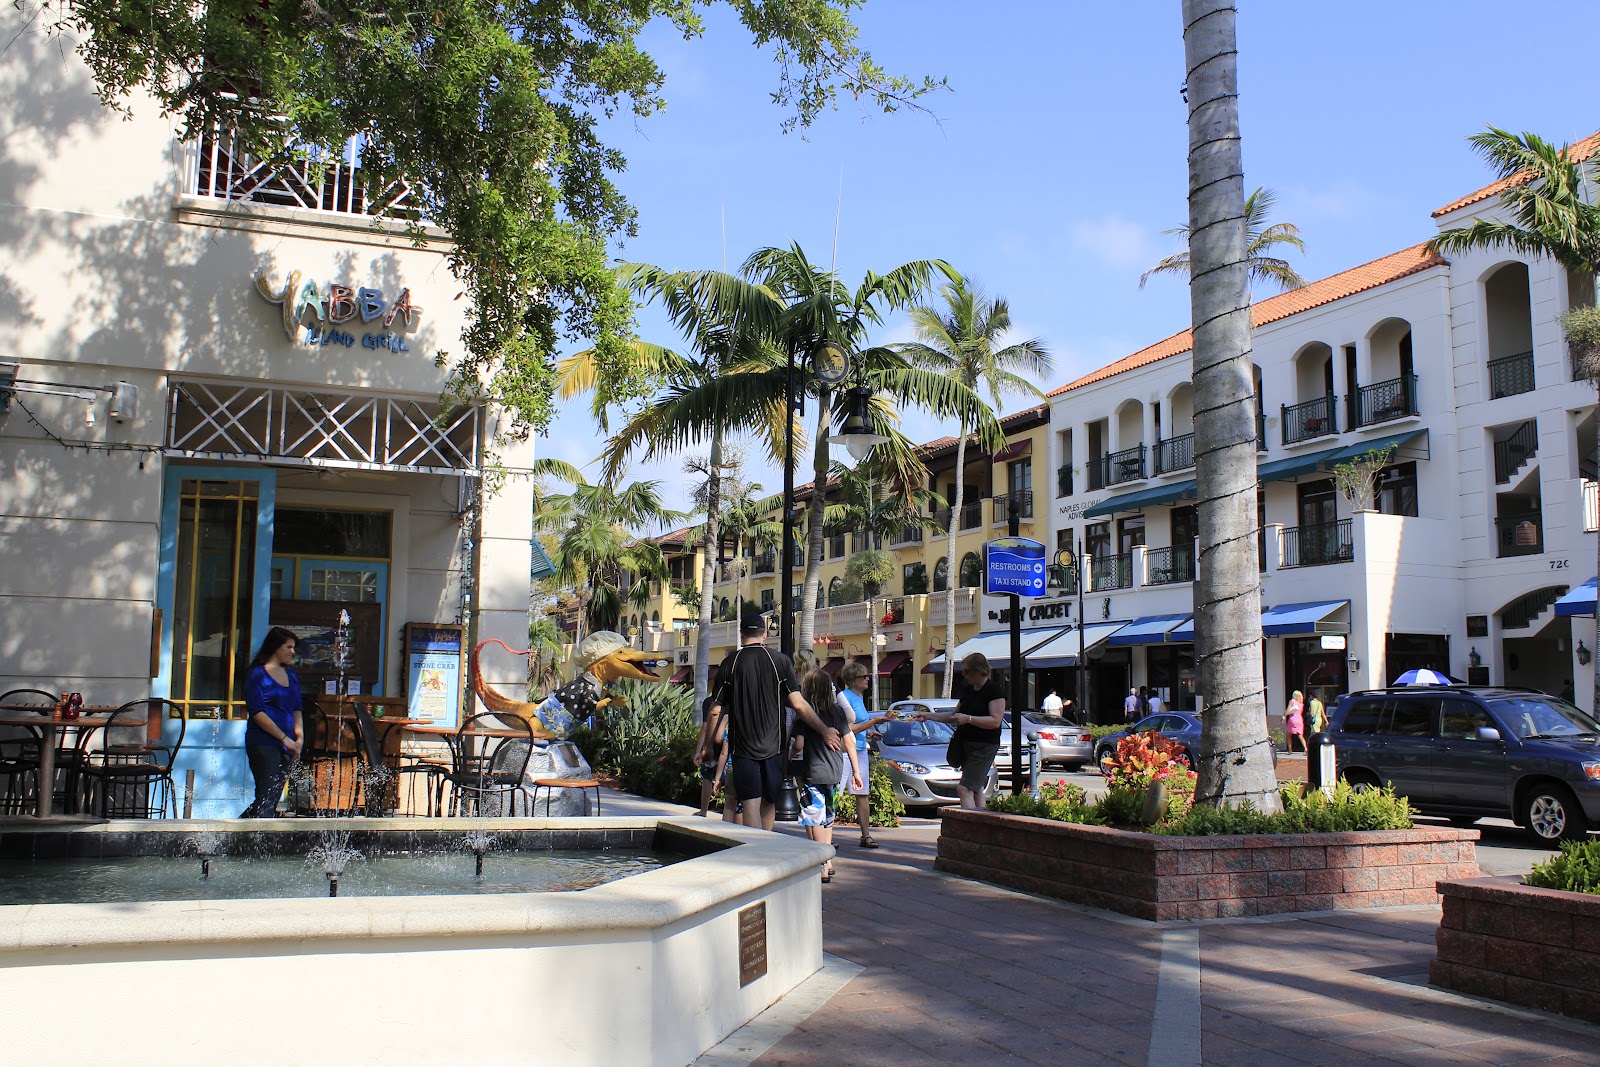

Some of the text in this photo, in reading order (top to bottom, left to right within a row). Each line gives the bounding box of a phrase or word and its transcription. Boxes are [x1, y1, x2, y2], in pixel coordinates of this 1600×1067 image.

[253, 266, 424, 341] YABBA
[1059, 503, 1080, 515] NAPLES
[990, 562, 1031, 572] RESTROOMS
[995, 577, 1031, 587] TAXI STAND
